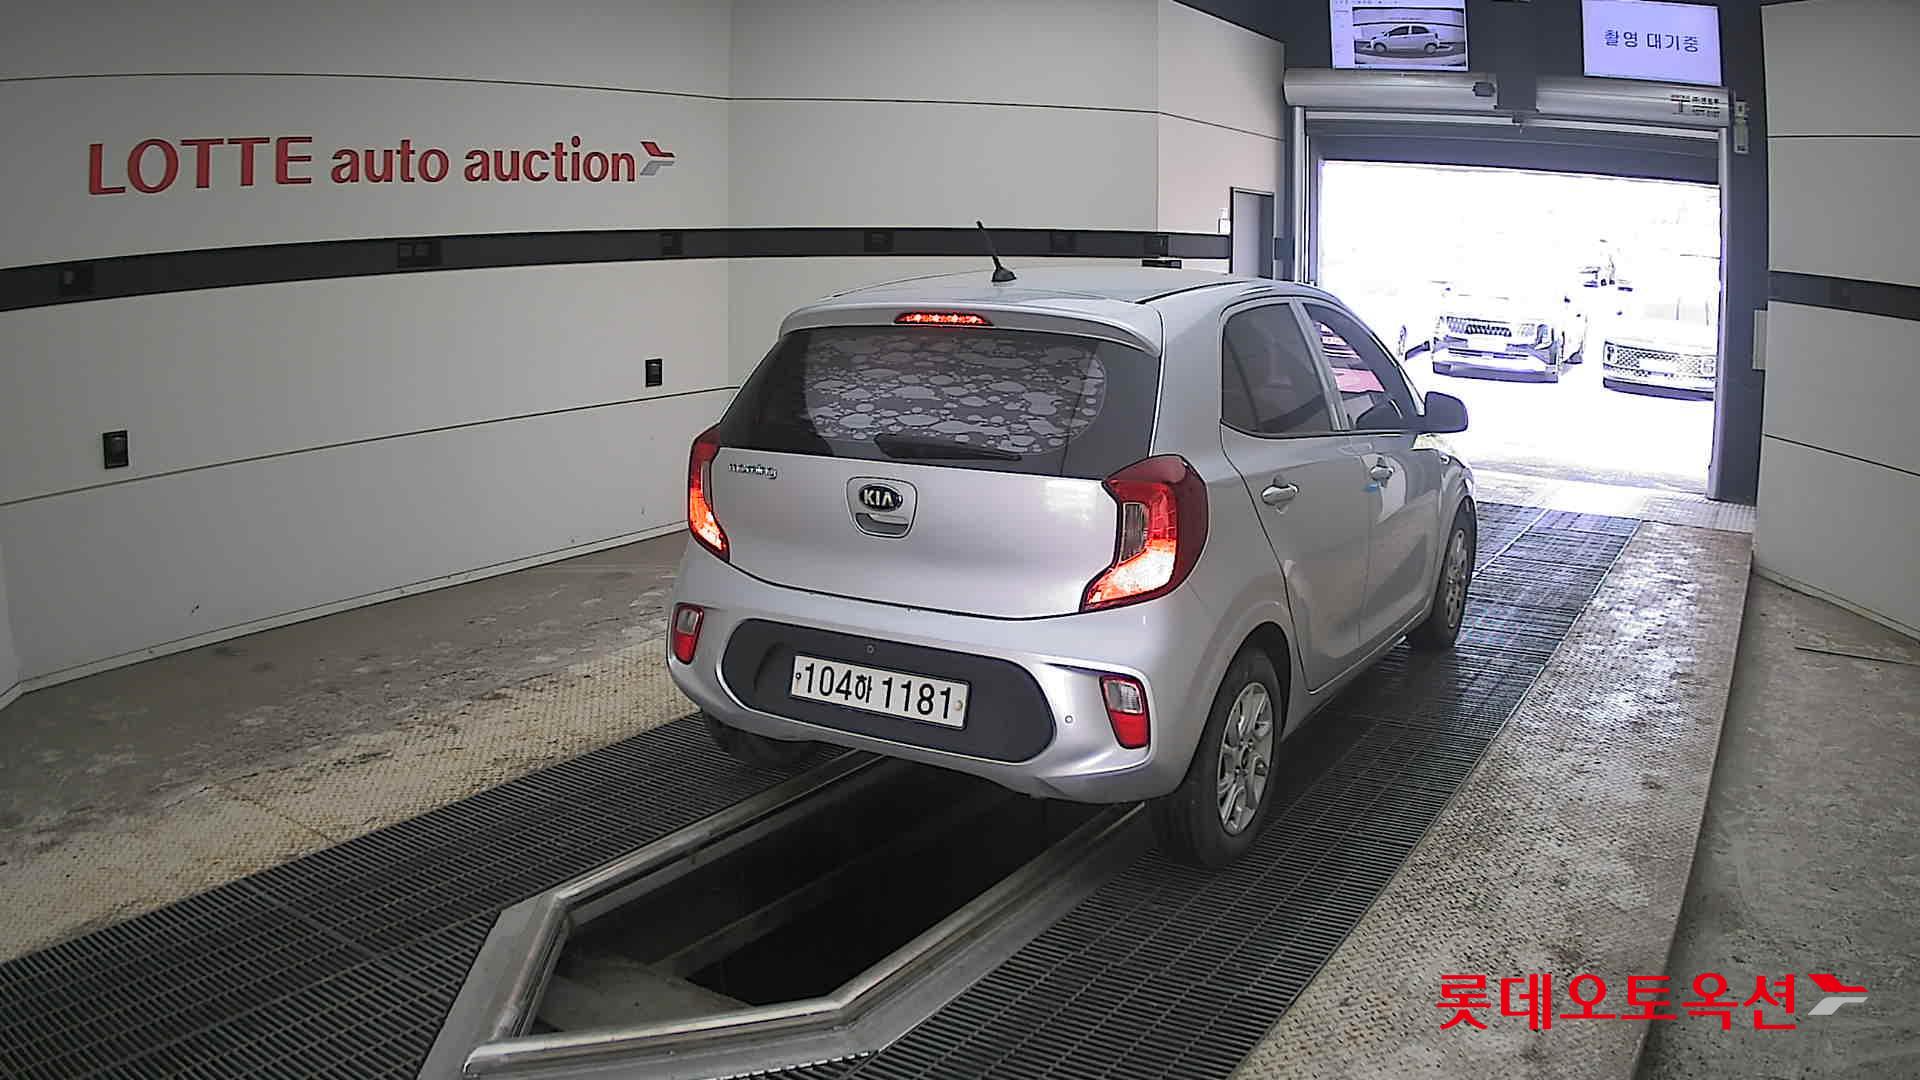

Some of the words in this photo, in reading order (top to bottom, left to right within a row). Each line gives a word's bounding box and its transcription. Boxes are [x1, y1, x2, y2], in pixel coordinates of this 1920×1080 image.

[1605, 29, 1638, 48] 촬영
[1646, 33, 1699, 52] 대기중
[88, 136, 313, 195] LOTTE
[330, 139, 450, 184] auto
[463, 136, 636, 182] auction
[863, 488, 894, 507] KIA
[804, 662, 873, 704] 104하
[881, 676, 952, 720] 1181
